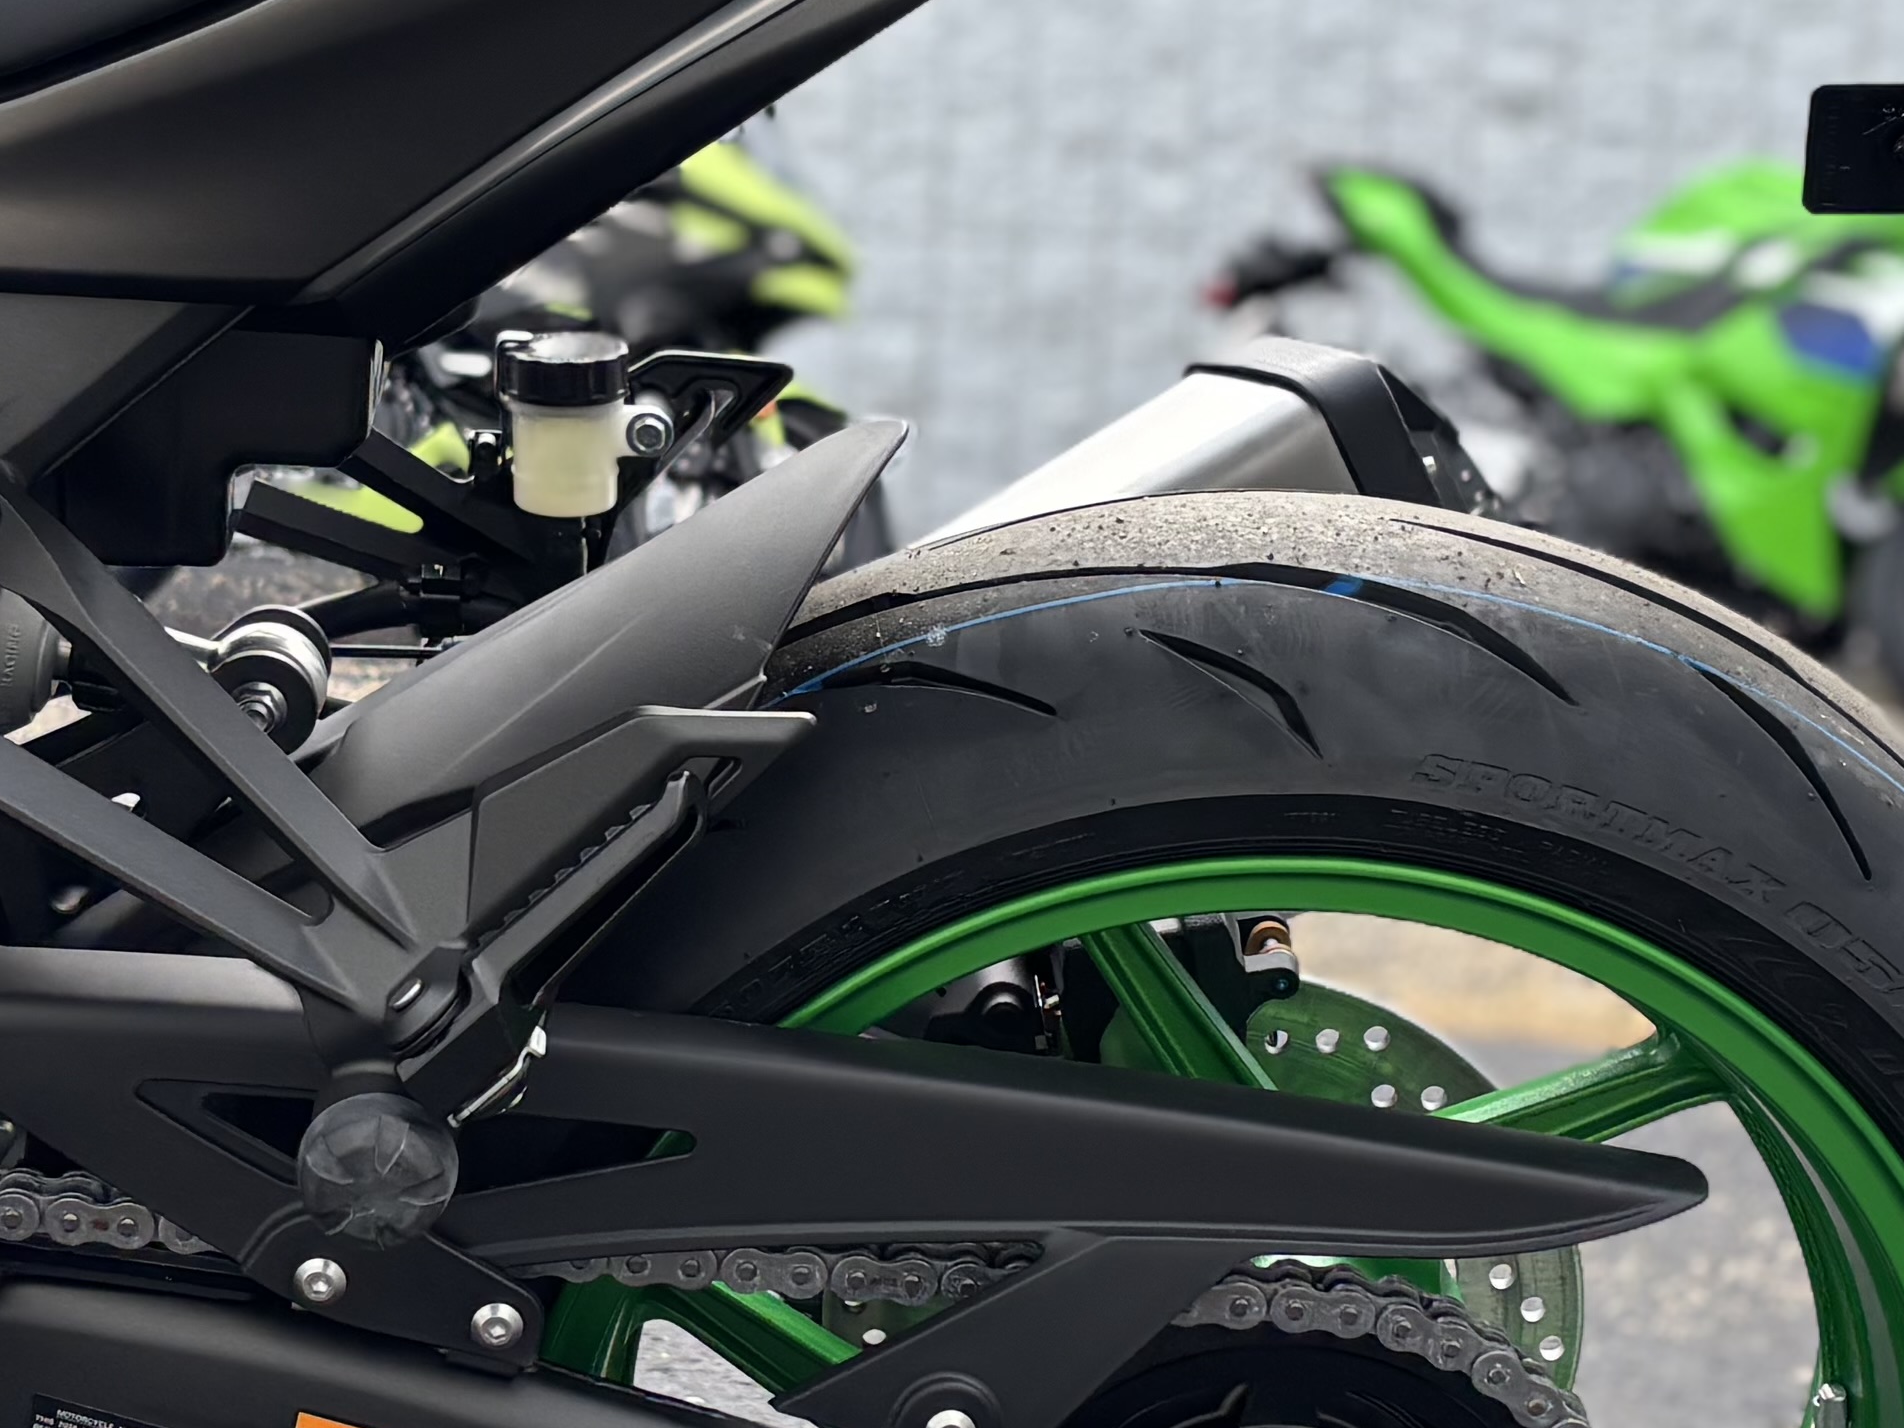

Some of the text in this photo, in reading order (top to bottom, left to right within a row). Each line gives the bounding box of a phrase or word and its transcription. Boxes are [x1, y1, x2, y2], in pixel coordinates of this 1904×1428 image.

[0, 623, 22, 688] RACING
[1410, 752, 1788, 904] SPORTMAX
[35, 1415, 54, 1425] THIS
